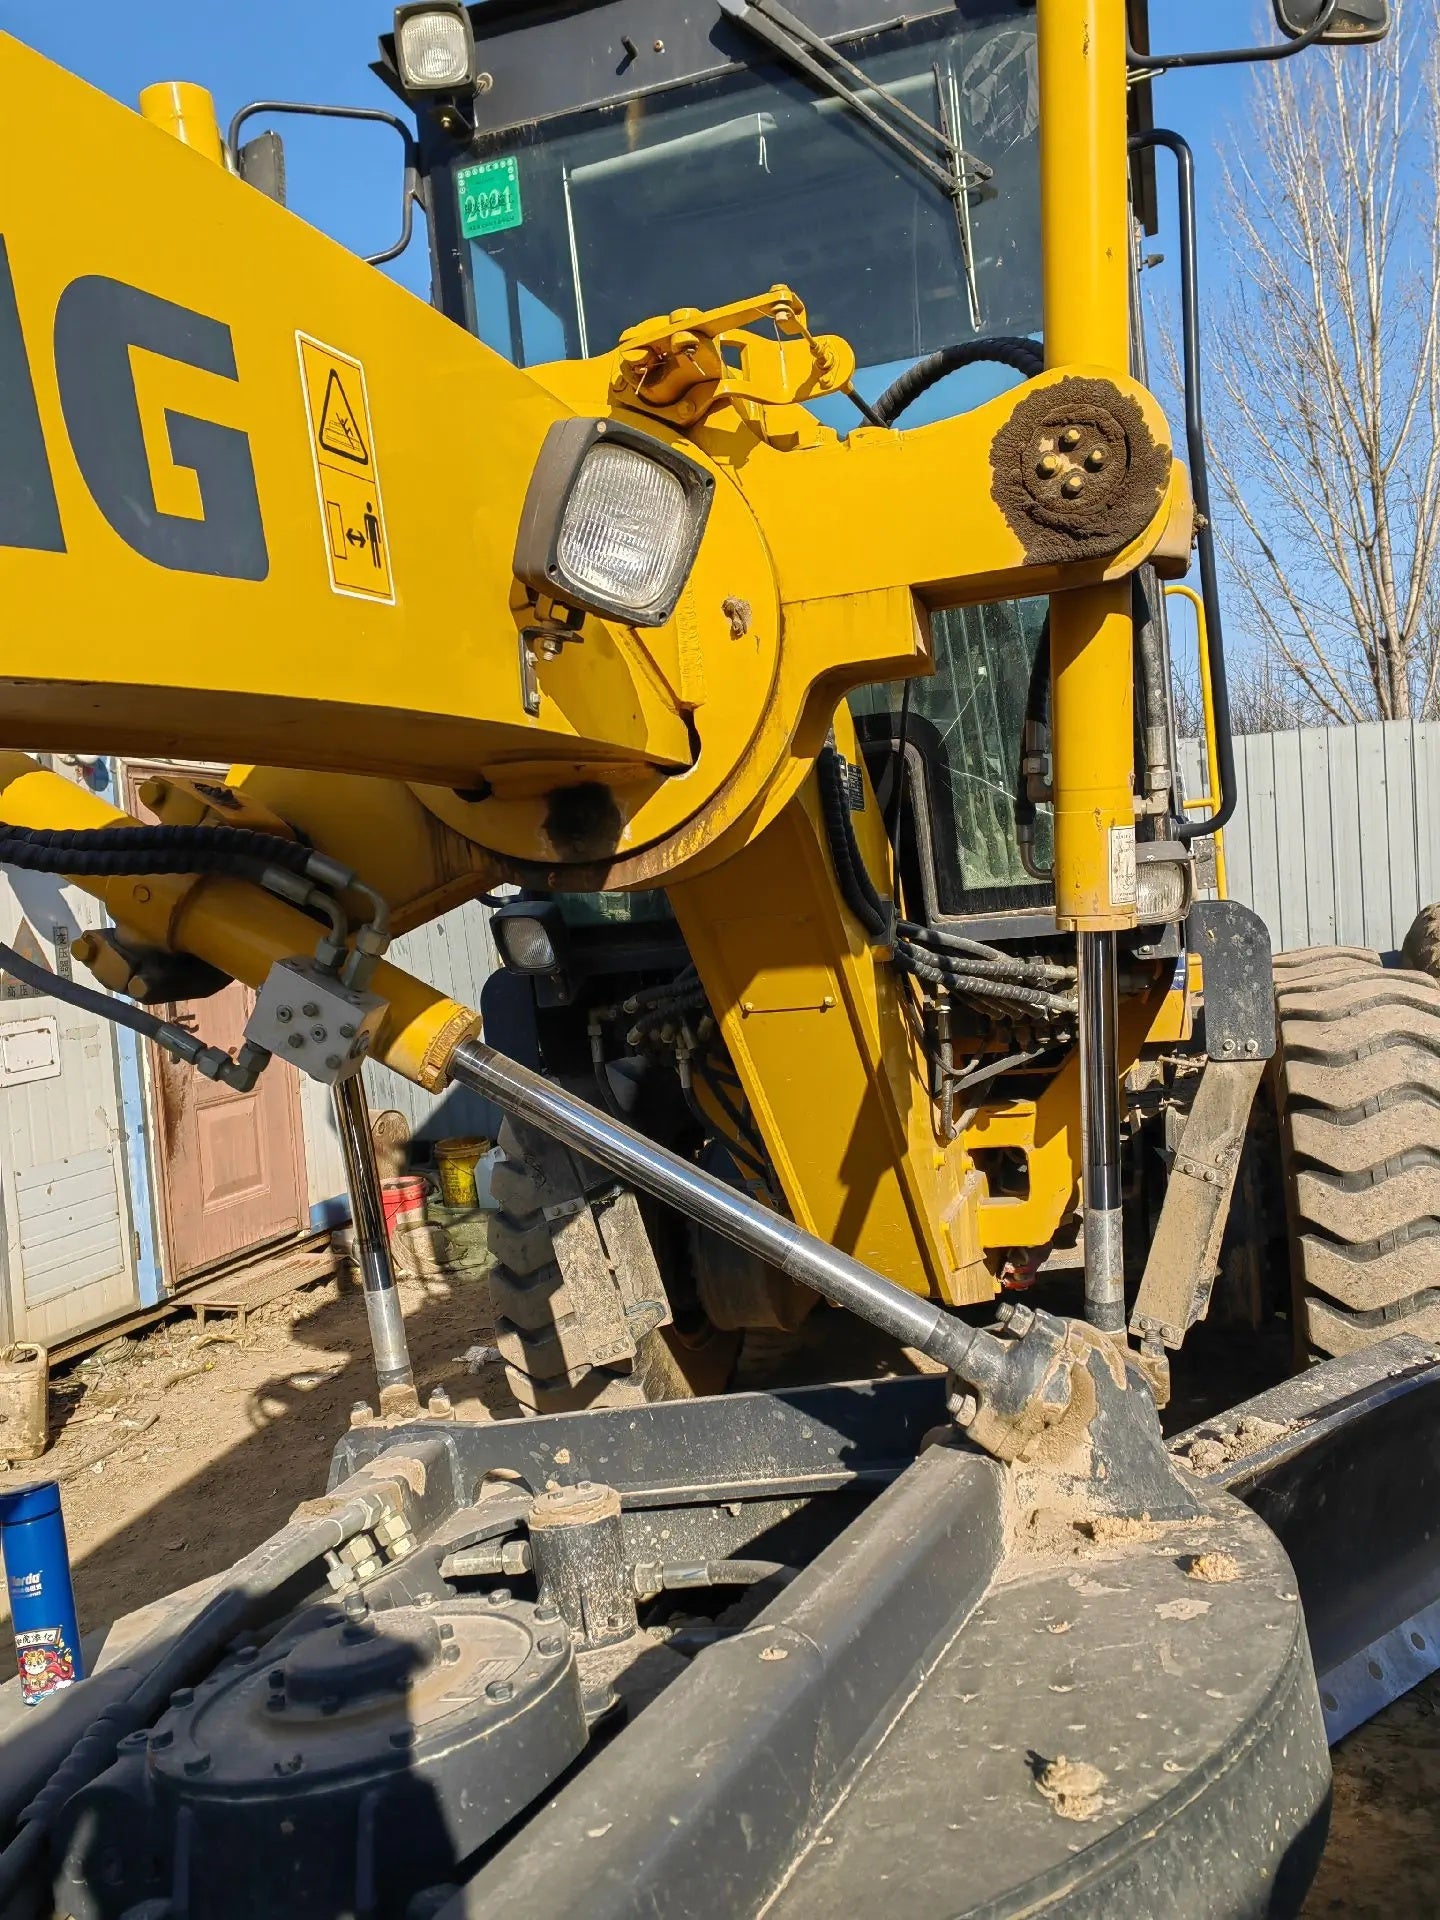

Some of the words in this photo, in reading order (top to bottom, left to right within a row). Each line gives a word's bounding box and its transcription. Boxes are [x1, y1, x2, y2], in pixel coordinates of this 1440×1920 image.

[465, 186, 514, 223] 2021
[56, 932, 70, 979] 变压器
